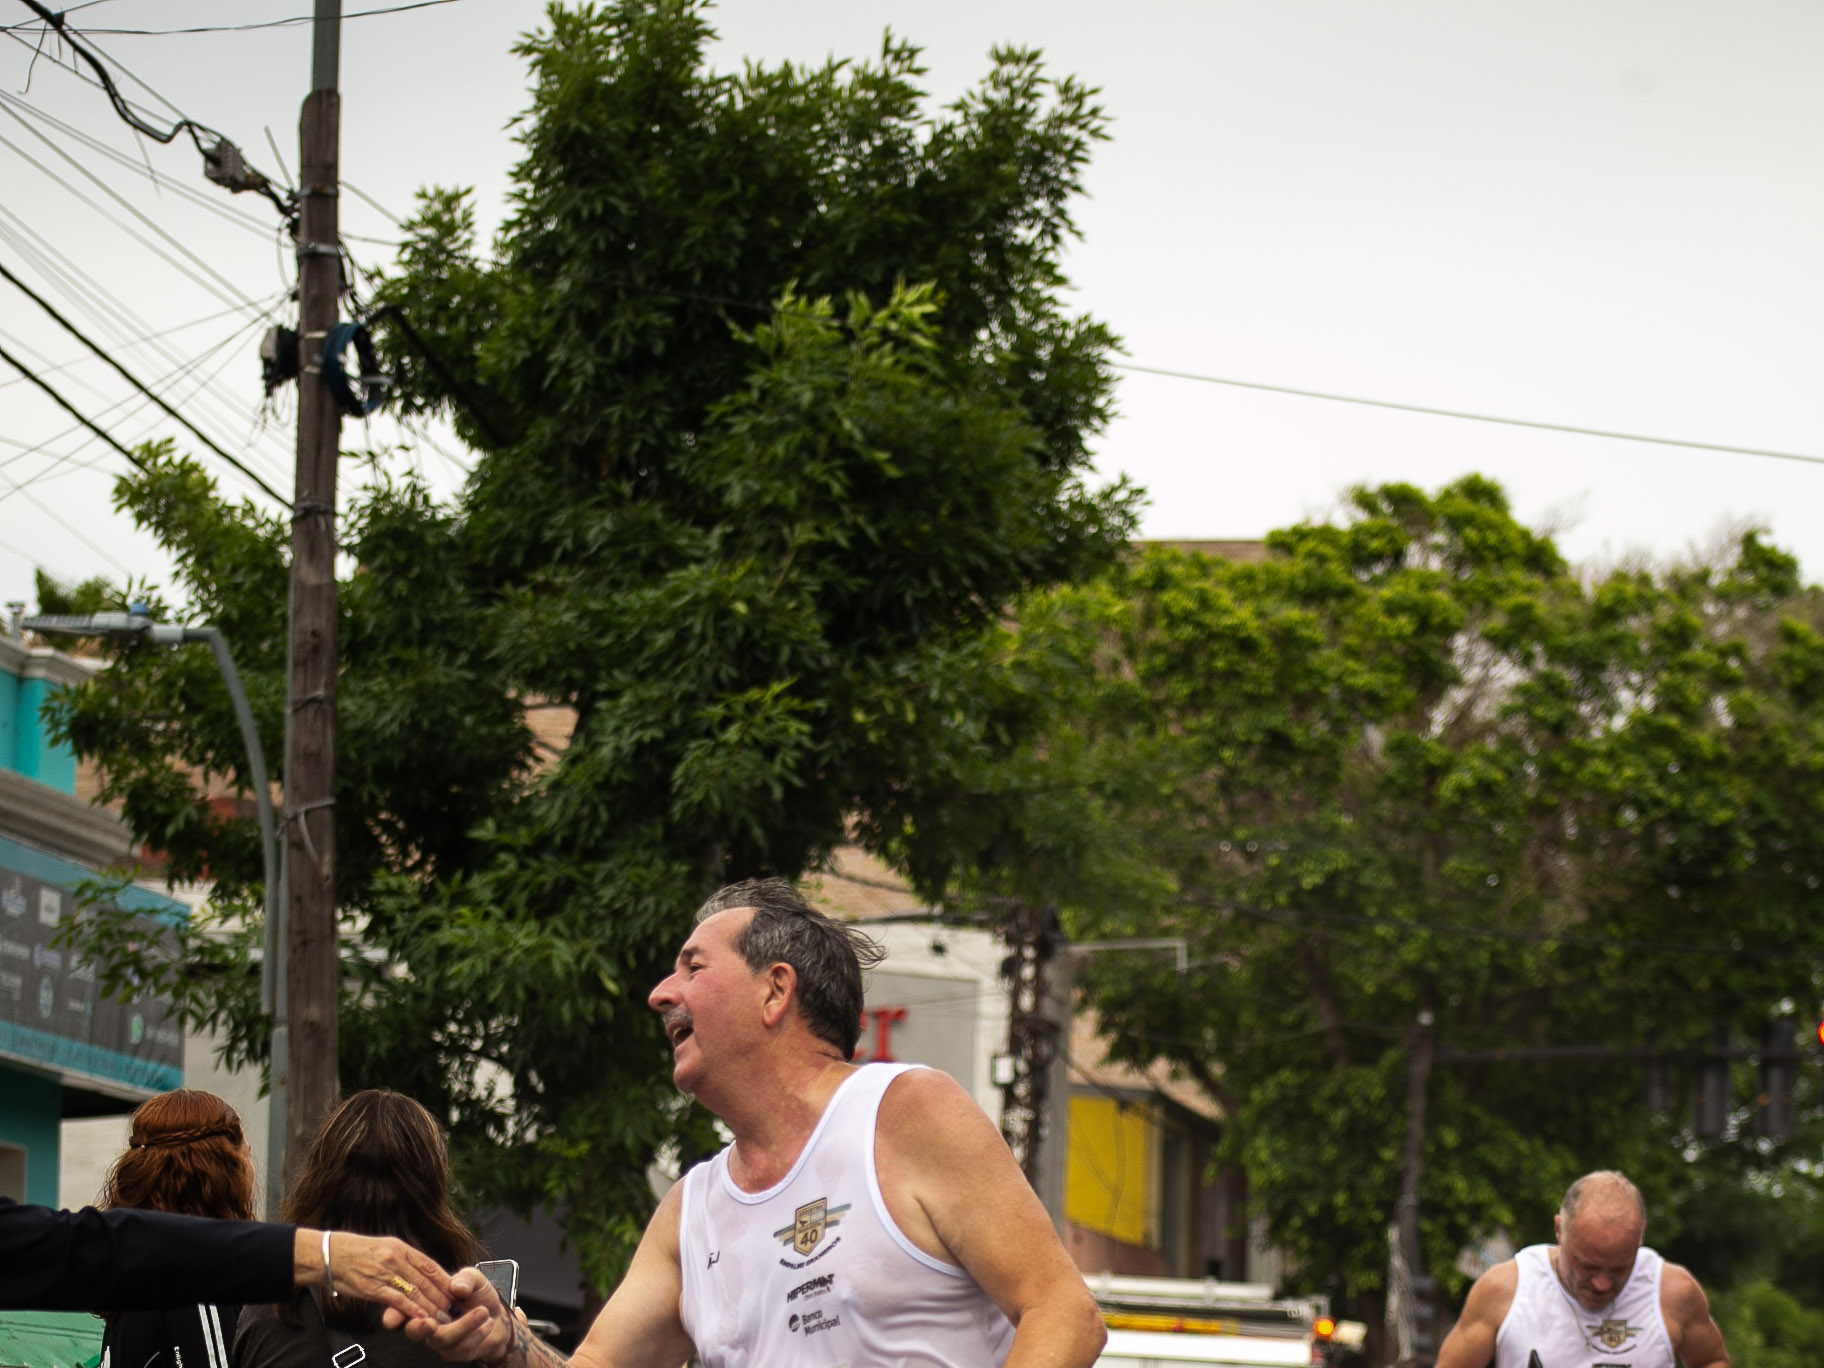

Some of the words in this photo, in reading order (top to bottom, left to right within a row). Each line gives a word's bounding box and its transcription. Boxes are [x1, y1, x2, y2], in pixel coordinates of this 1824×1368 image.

[800, 1229, 818, 1246] 40
[802, 1310, 822, 1325] Banco
[804, 1314, 841, 1336] Municipal
